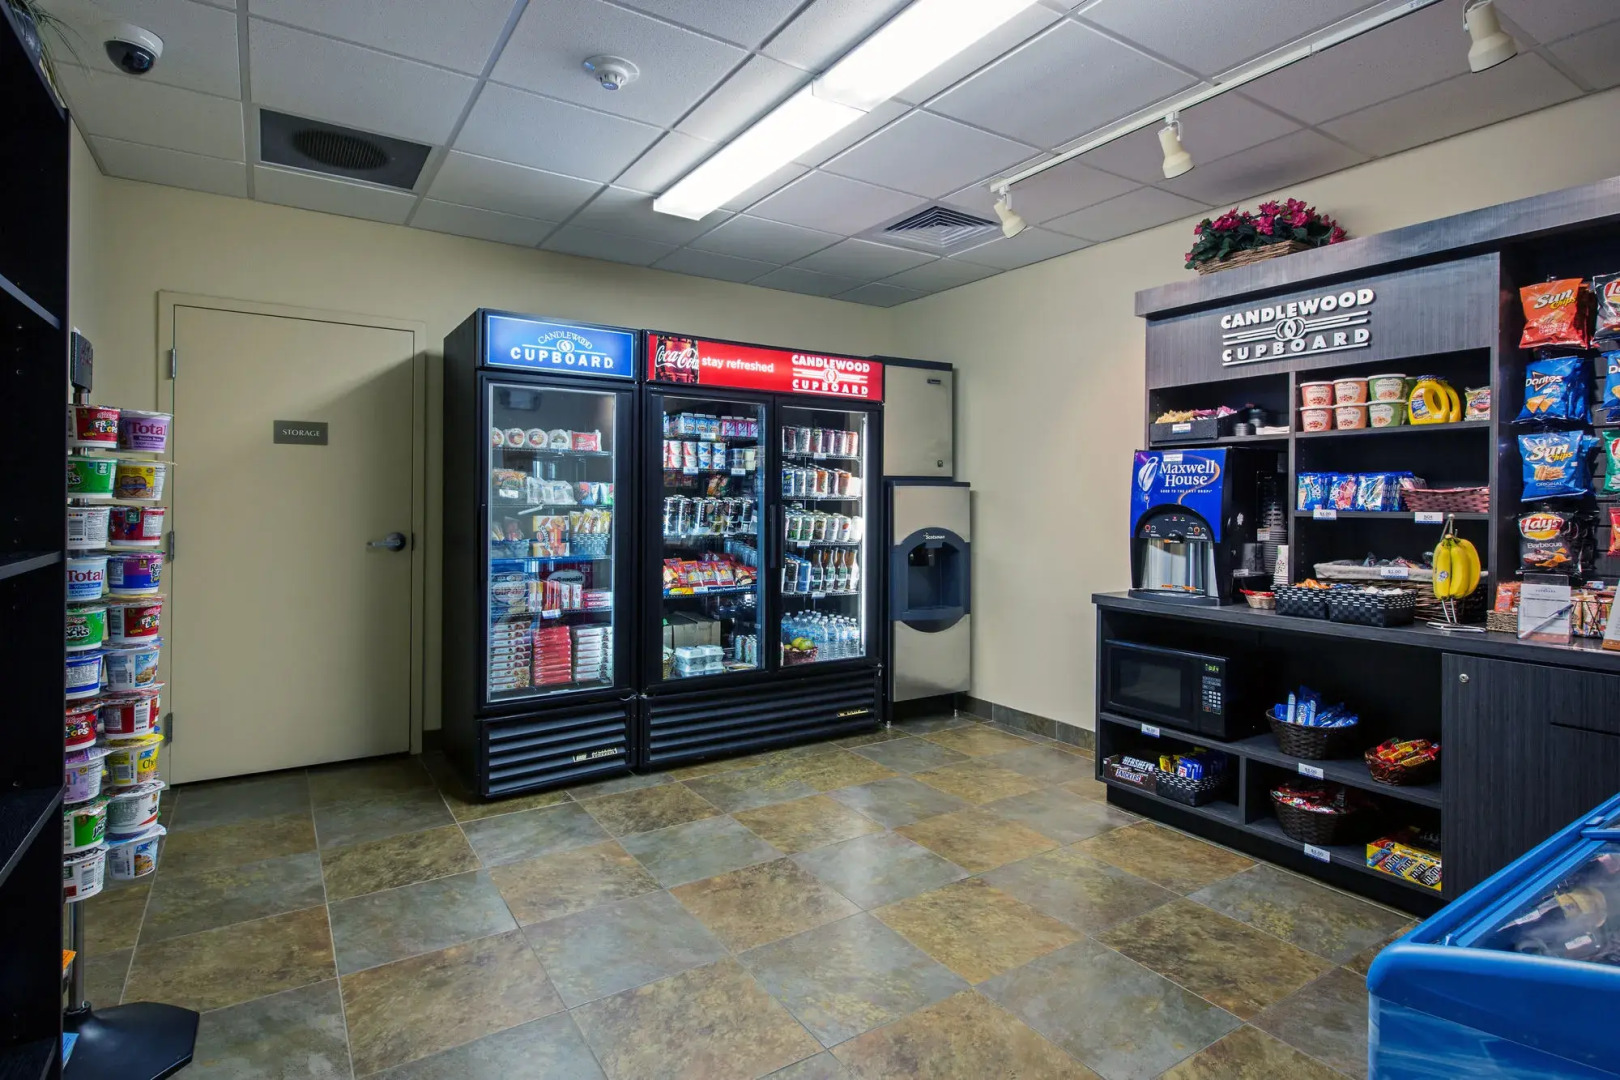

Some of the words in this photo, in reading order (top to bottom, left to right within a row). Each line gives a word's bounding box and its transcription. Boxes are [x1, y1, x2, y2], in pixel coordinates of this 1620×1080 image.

[1533, 289, 1574, 309] Sun
[1221, 288, 1374, 329] CANDLEWOOD
[537, 330, 593, 350] CANDLEWOOD
[1222, 328, 1370, 362] CUPBOARD
[510, 347, 614, 369] CUPBOARD
[655, 345, 700, 370] Coca-Cola
[702, 356, 724, 369] stay
[726, 358, 775, 373] refreshed
[791, 354, 870, 373] CANDLEWOOD
[792, 378, 869, 395] CUPBOARD
[1525, 375, 1563, 387] Doritos
[131, 421, 167, 436] Total
[282, 428, 320, 437] STORAGE
[1528, 444, 1570, 461] Sun
[1160, 460, 1216, 474] Maxwell
[1164, 474, 1208, 487] House
[67, 569, 104, 582] Total
